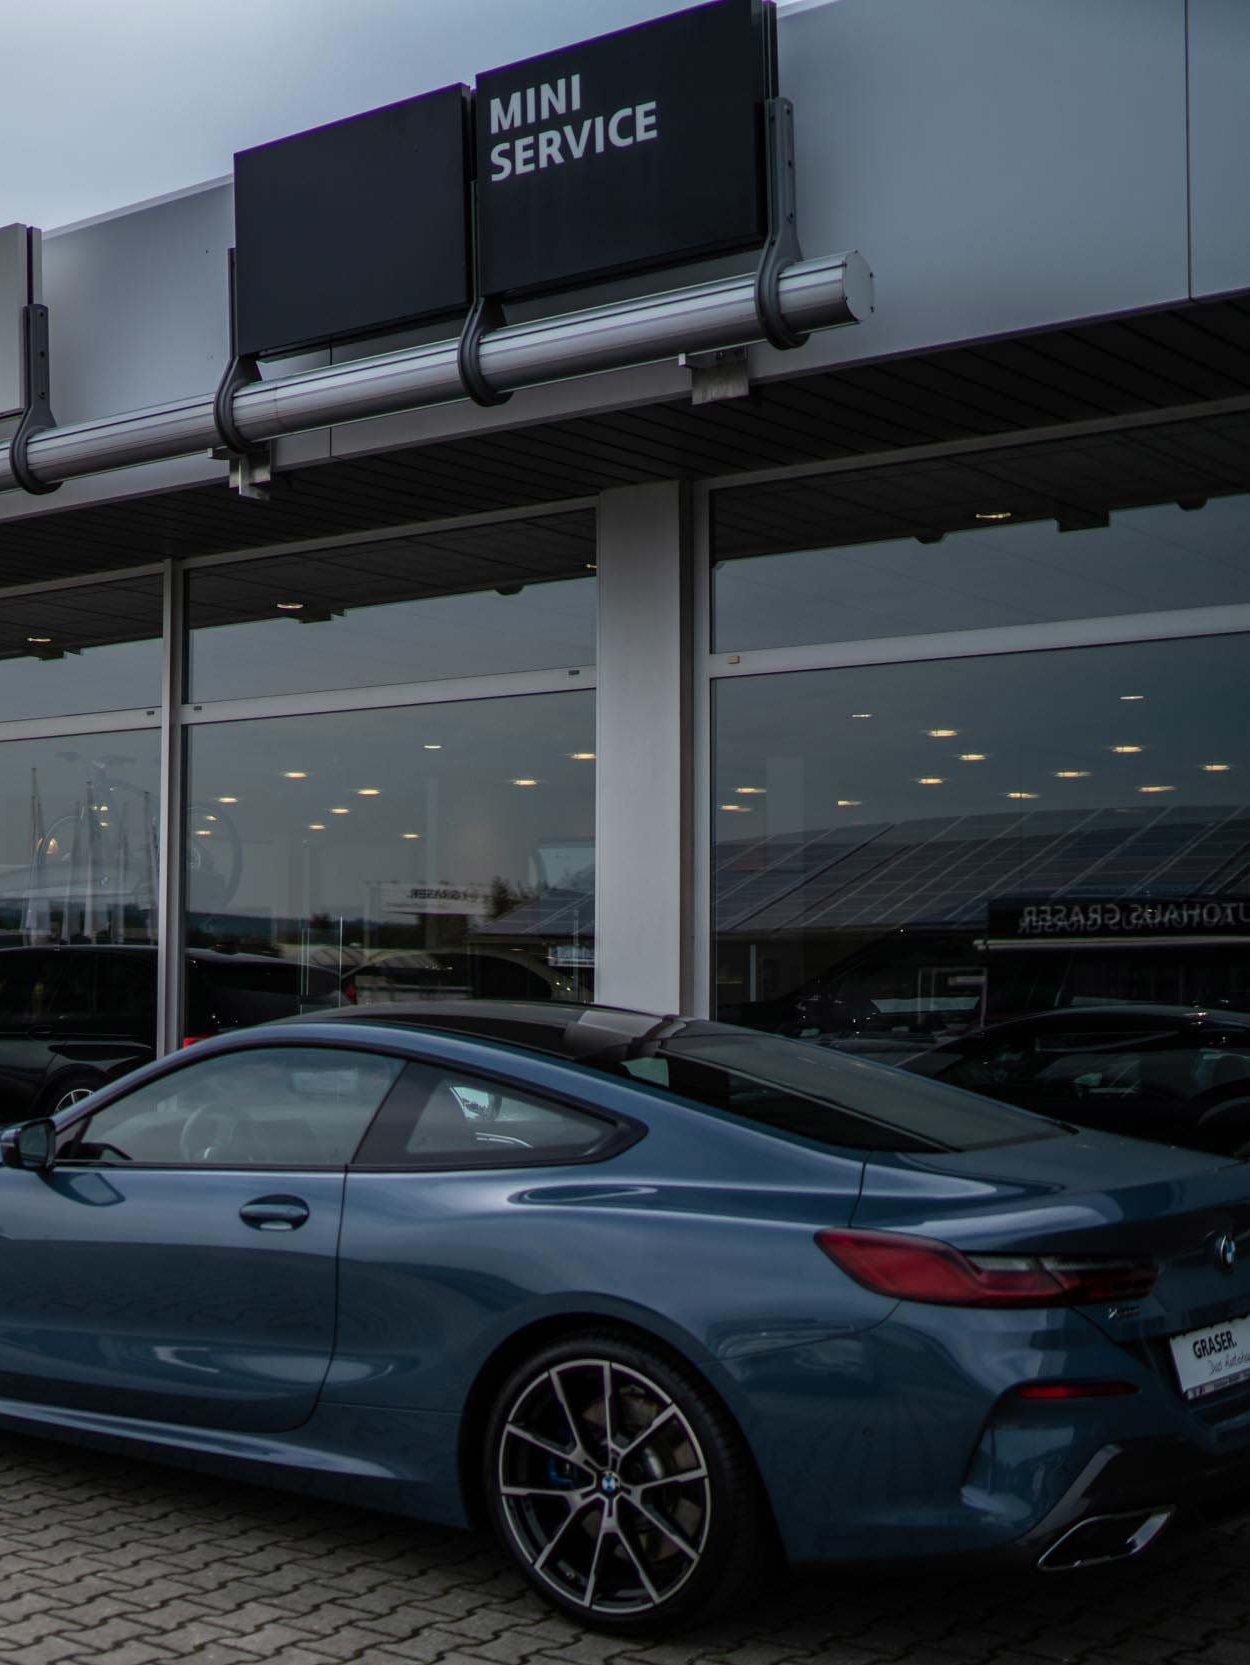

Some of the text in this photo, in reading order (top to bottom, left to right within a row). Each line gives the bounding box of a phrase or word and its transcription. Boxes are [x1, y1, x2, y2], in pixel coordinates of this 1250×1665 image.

[490, 73, 580, 134] MINI
[490, 100, 658, 182] SERVICE
[1193, 1330, 1238, 1359] GRASER.
